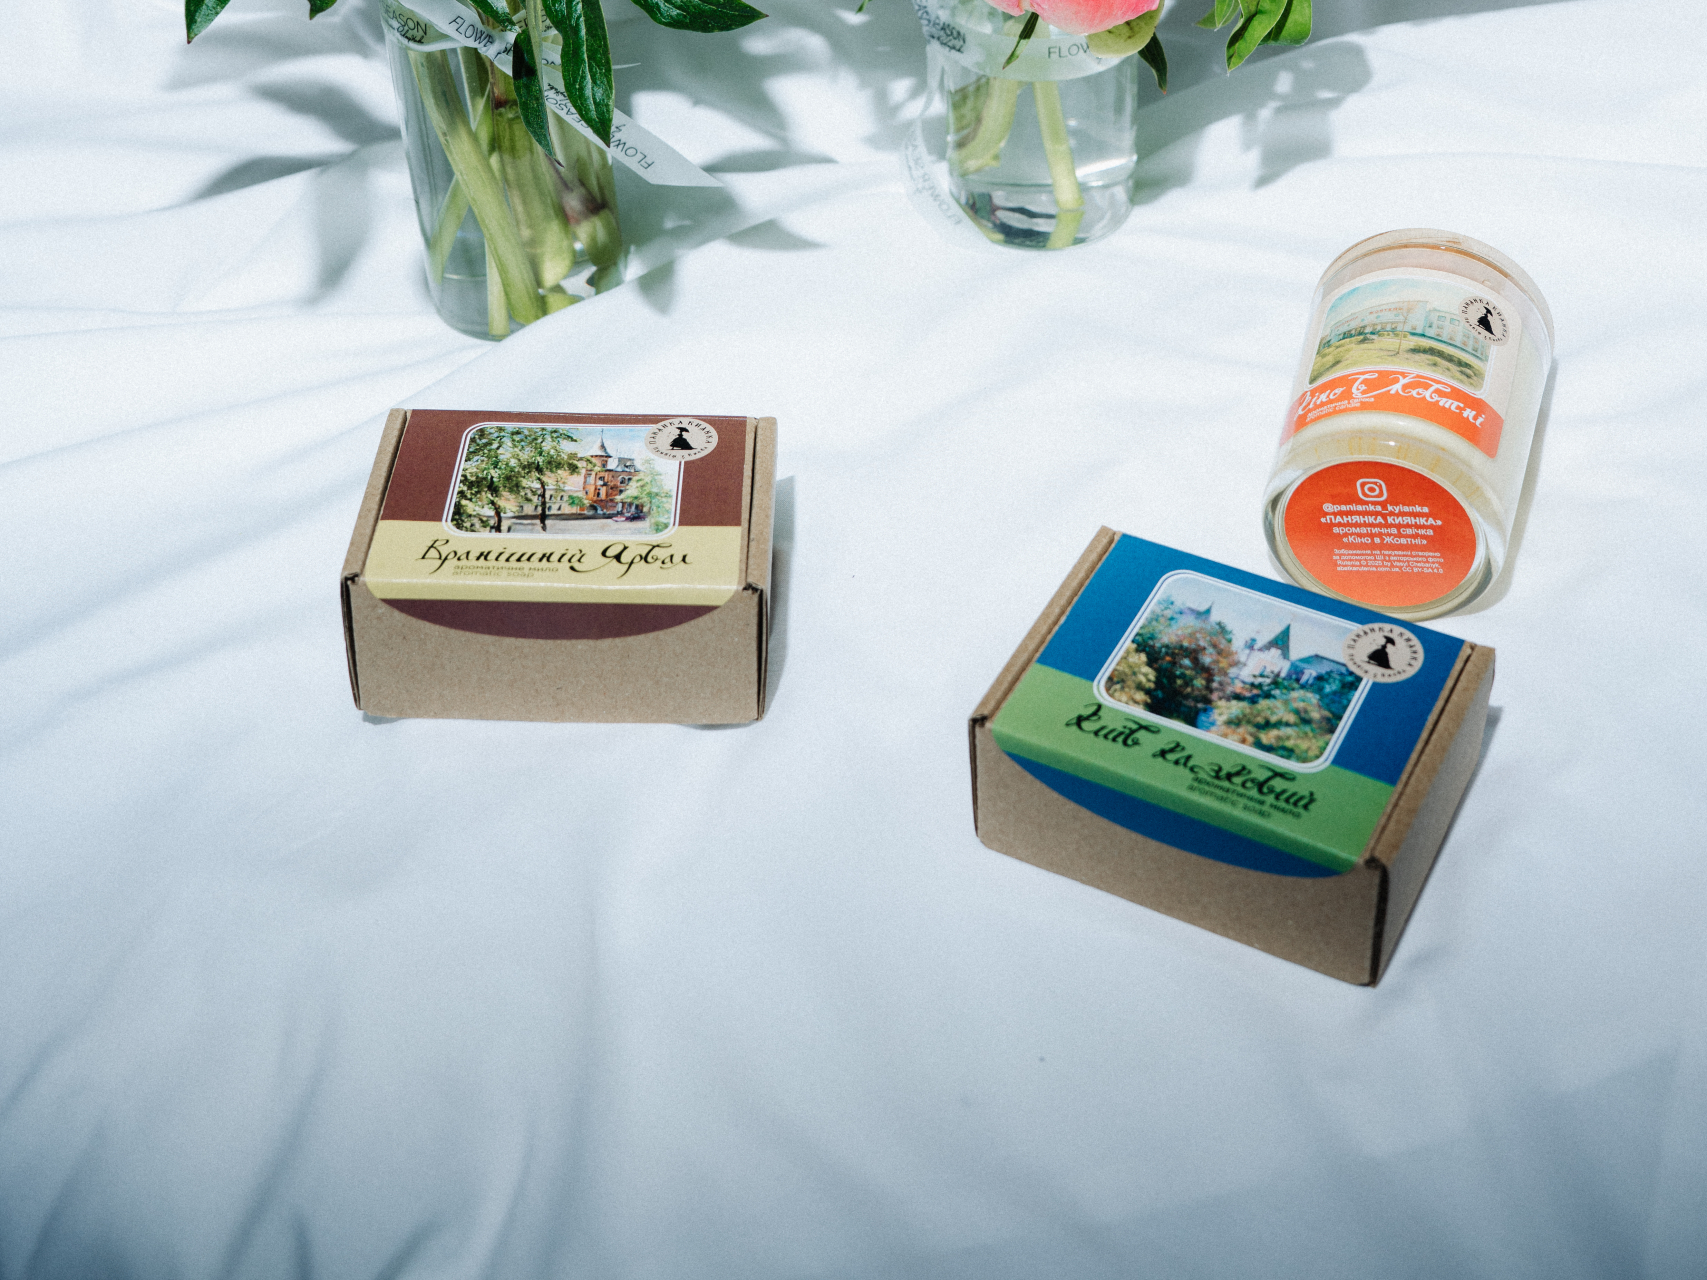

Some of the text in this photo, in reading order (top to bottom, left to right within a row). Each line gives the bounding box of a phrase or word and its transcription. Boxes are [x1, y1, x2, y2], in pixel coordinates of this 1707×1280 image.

[1322, 502, 1430, 514] @panianka_kyianka
[1320, 515, 1443, 526] «ПАНЯНКА КИЯНКА»
[1332, 526, 1435, 536] ароматична свічка
[1342, 535, 1428, 545] «Кіно в Жовтні»
